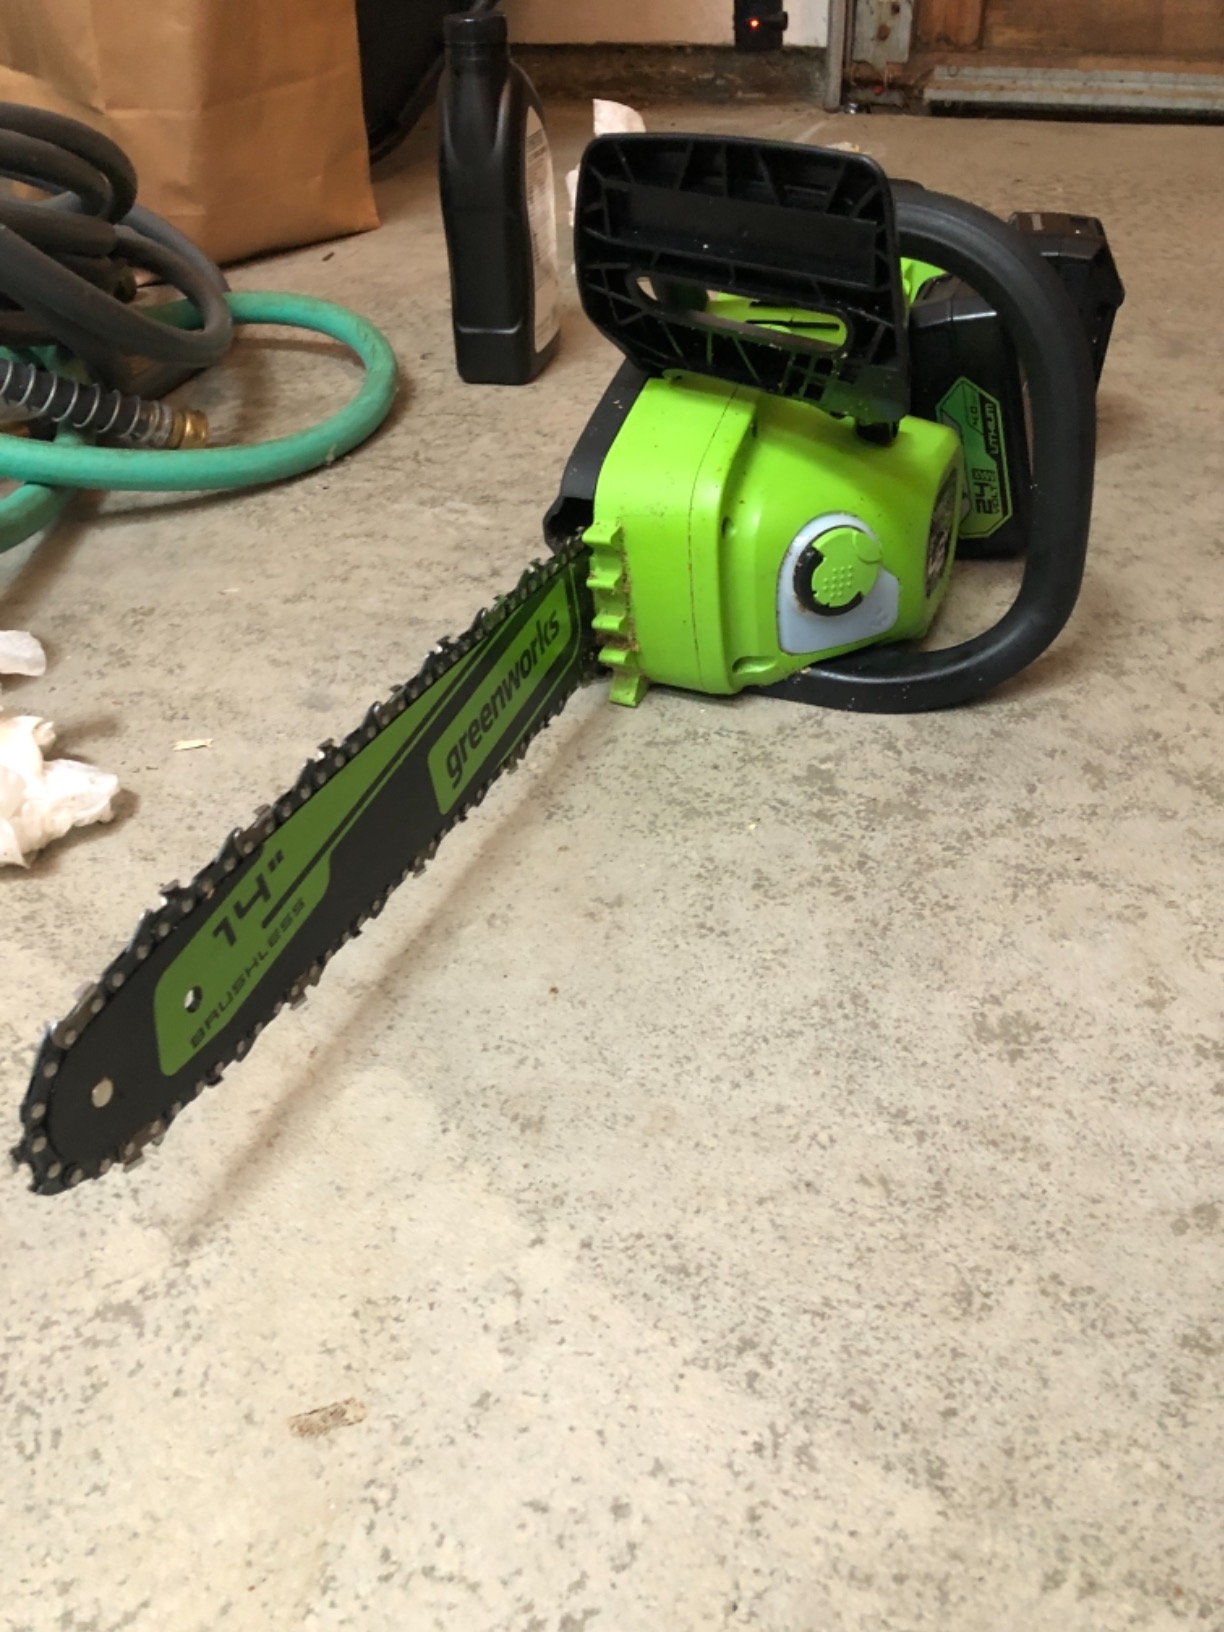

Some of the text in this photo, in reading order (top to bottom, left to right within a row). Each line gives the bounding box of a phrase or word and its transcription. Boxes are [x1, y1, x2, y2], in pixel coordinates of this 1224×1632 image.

[974, 482, 993, 514] 24
[446, 609, 560, 789] greenworks
[213, 850, 285, 947] 14"
[190, 898, 305, 1049] BRUSHLESS
